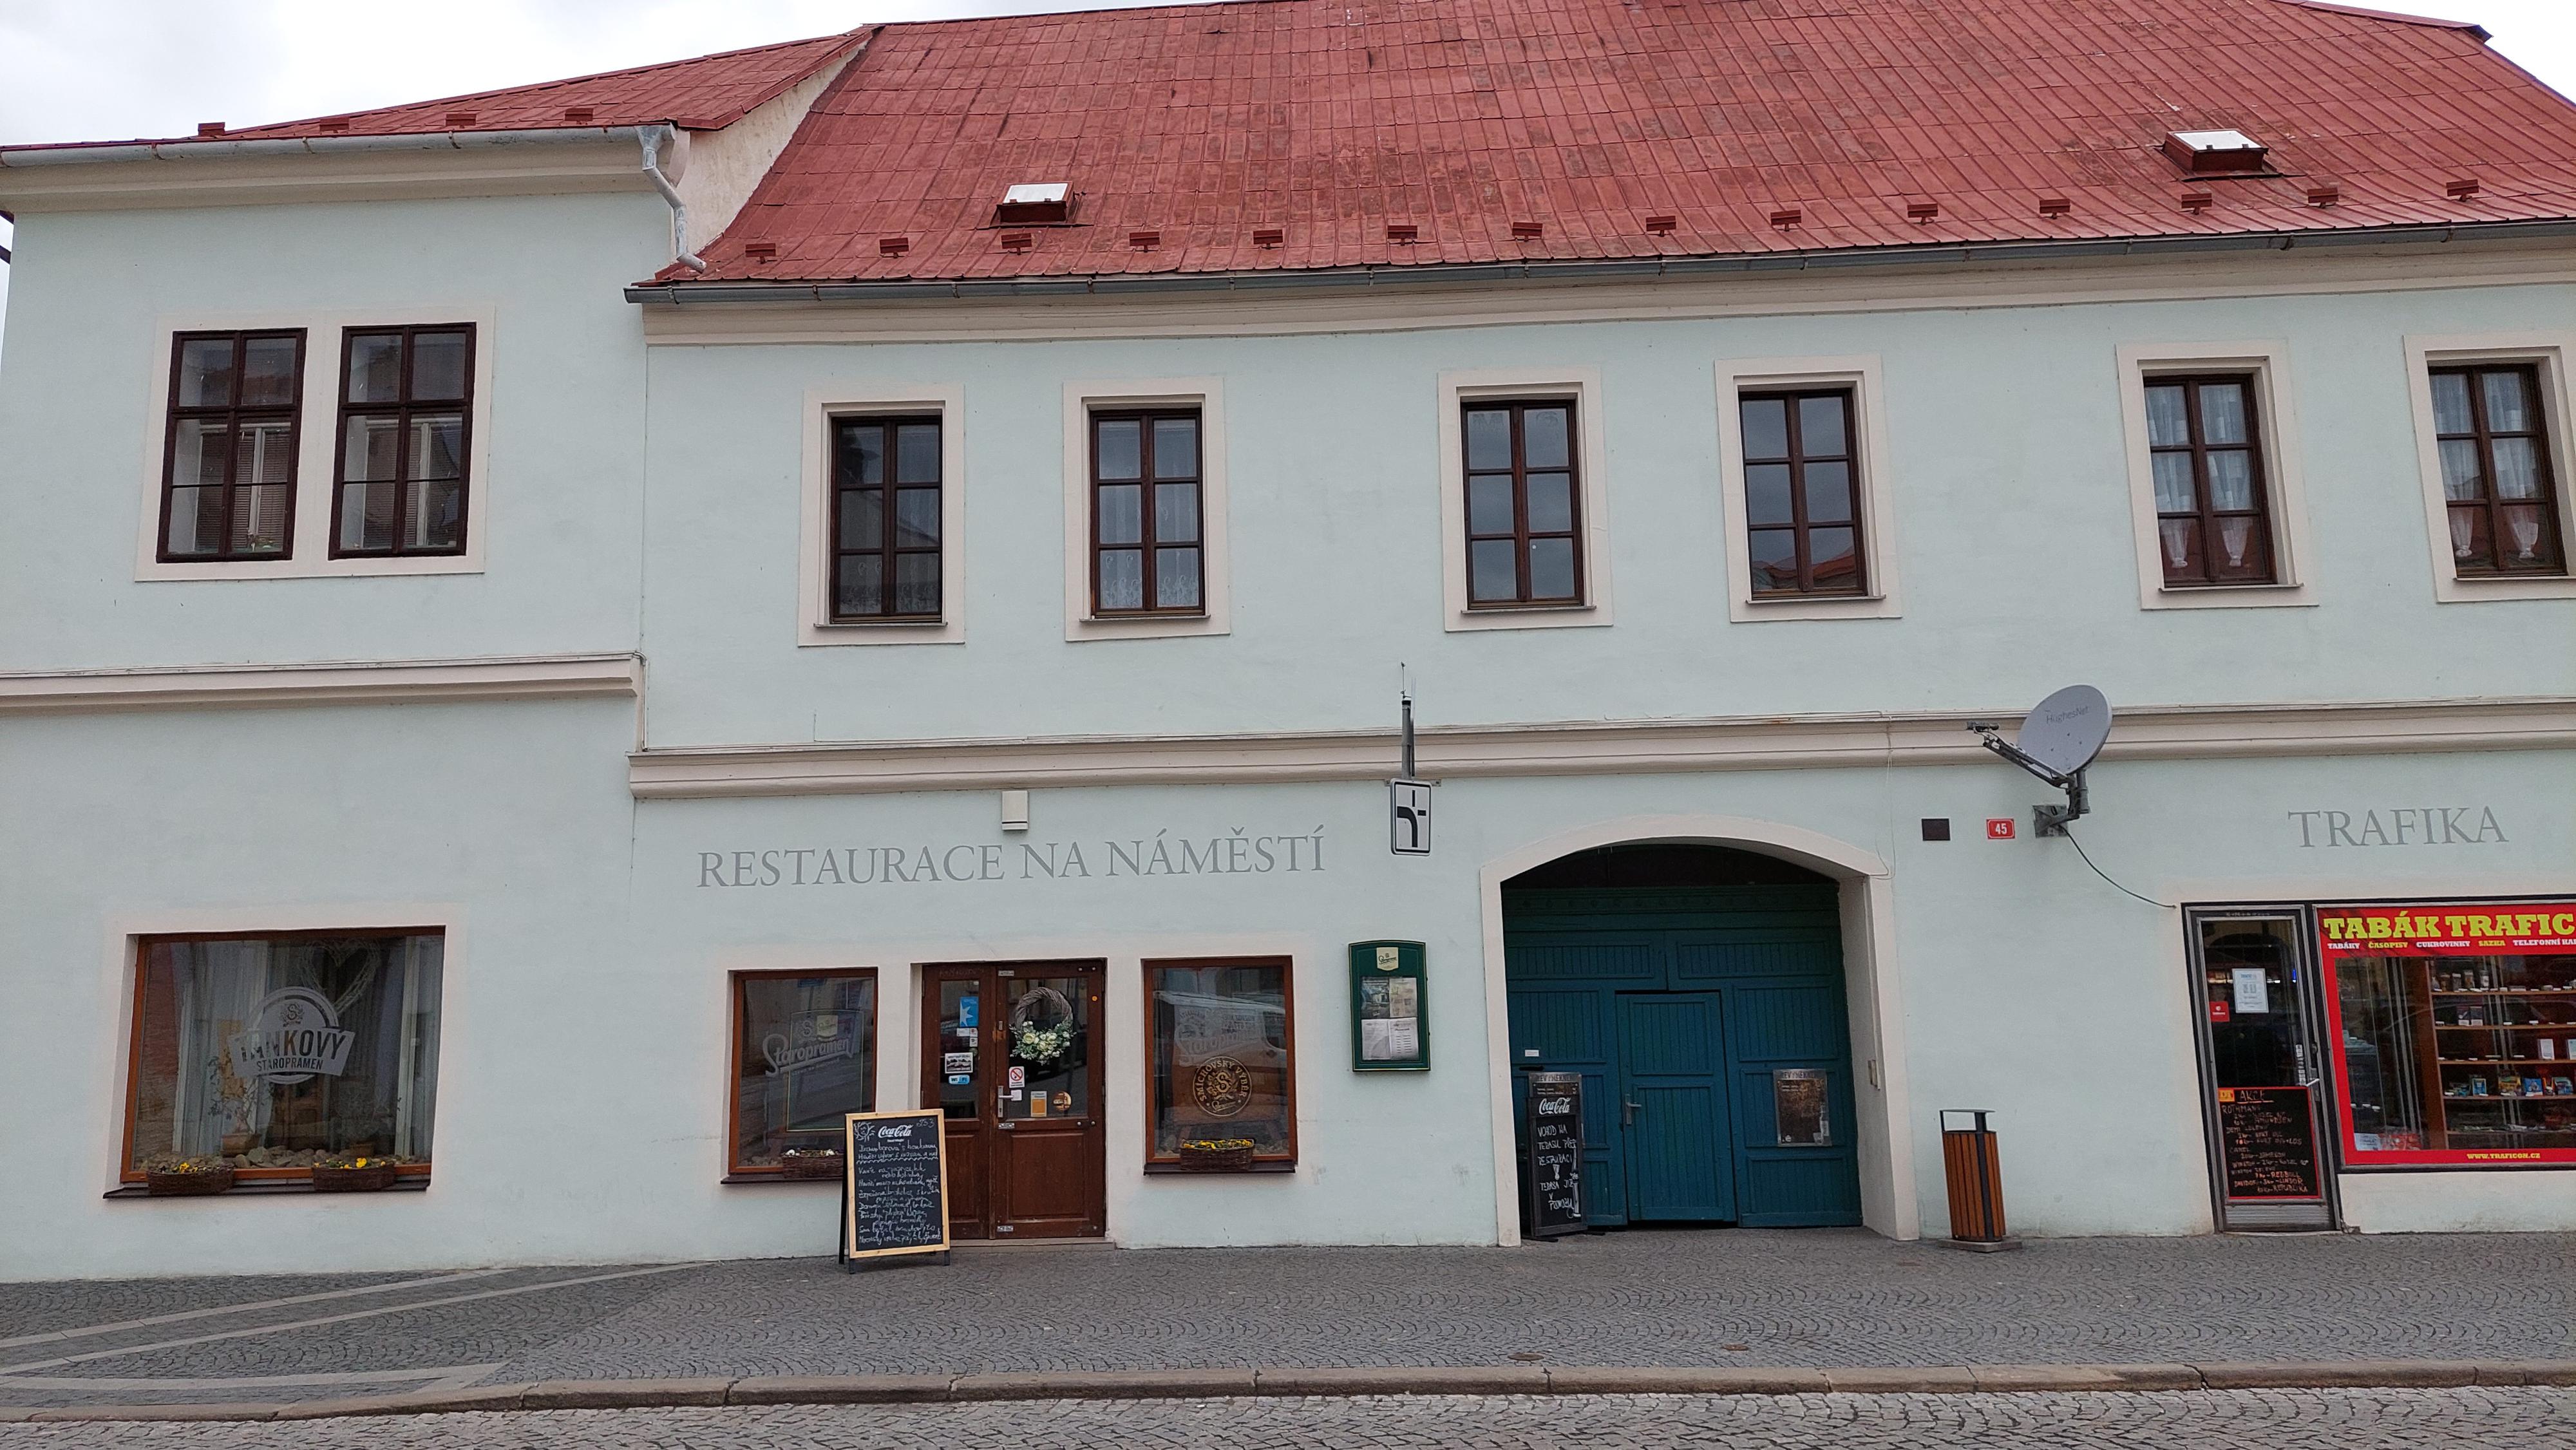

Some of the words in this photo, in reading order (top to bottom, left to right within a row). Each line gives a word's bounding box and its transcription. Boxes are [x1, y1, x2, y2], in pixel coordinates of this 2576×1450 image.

[1995, 823, 2007, 835] 45
[2288, 806, 2509, 847] TRAFIKA
[696, 845, 1005, 888] RESTAURACE
[1019, 841, 1092, 878] NA
[1105, 824, 1326, 876] NÁMĚSTÍ
[2324, 910, 2441, 940] TABÁK
[2513, 937, 2561, 946] TELEFONNÍ
[256, 1057, 323, 1072] STAROPRAMEN
[762, 1033, 853, 1077] Staropramen
